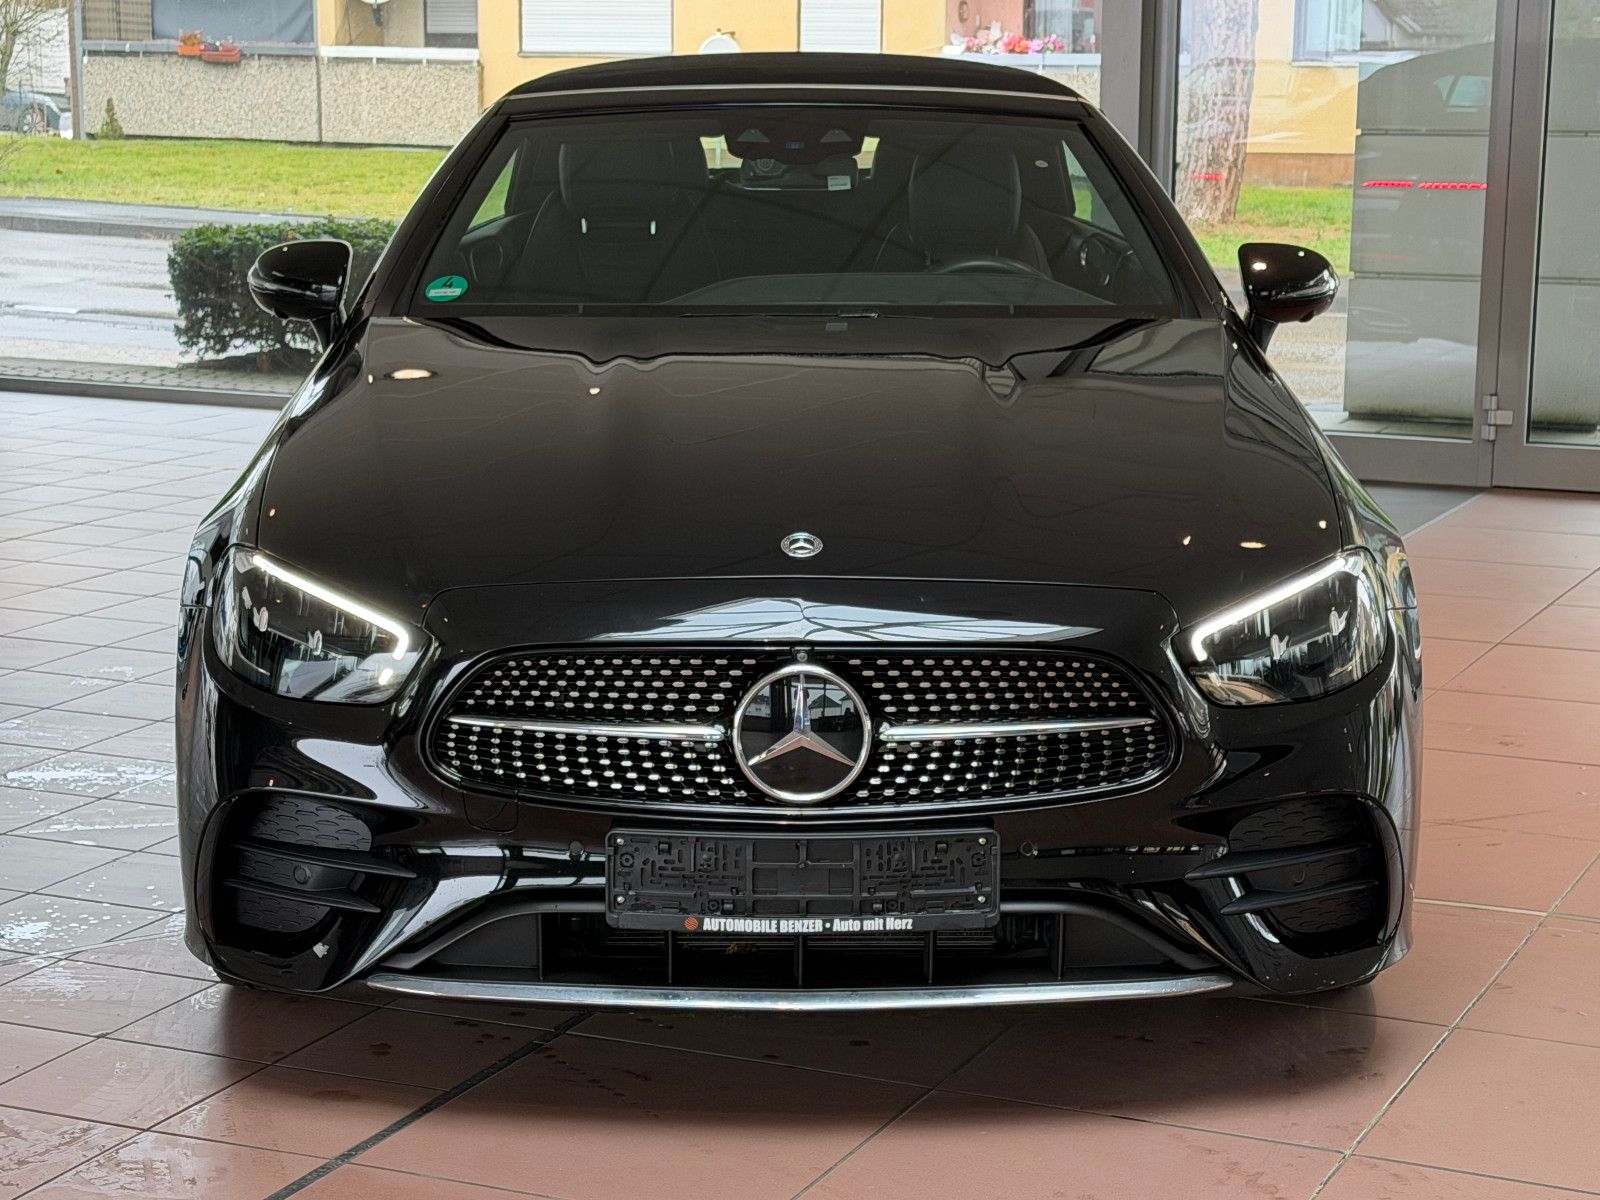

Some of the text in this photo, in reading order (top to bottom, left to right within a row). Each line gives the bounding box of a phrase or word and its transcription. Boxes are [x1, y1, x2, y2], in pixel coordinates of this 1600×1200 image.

[441, 276, 454, 288] 4
[703, 917, 913, 933] AUTOMOBILE BENZER Auto mit Herz
